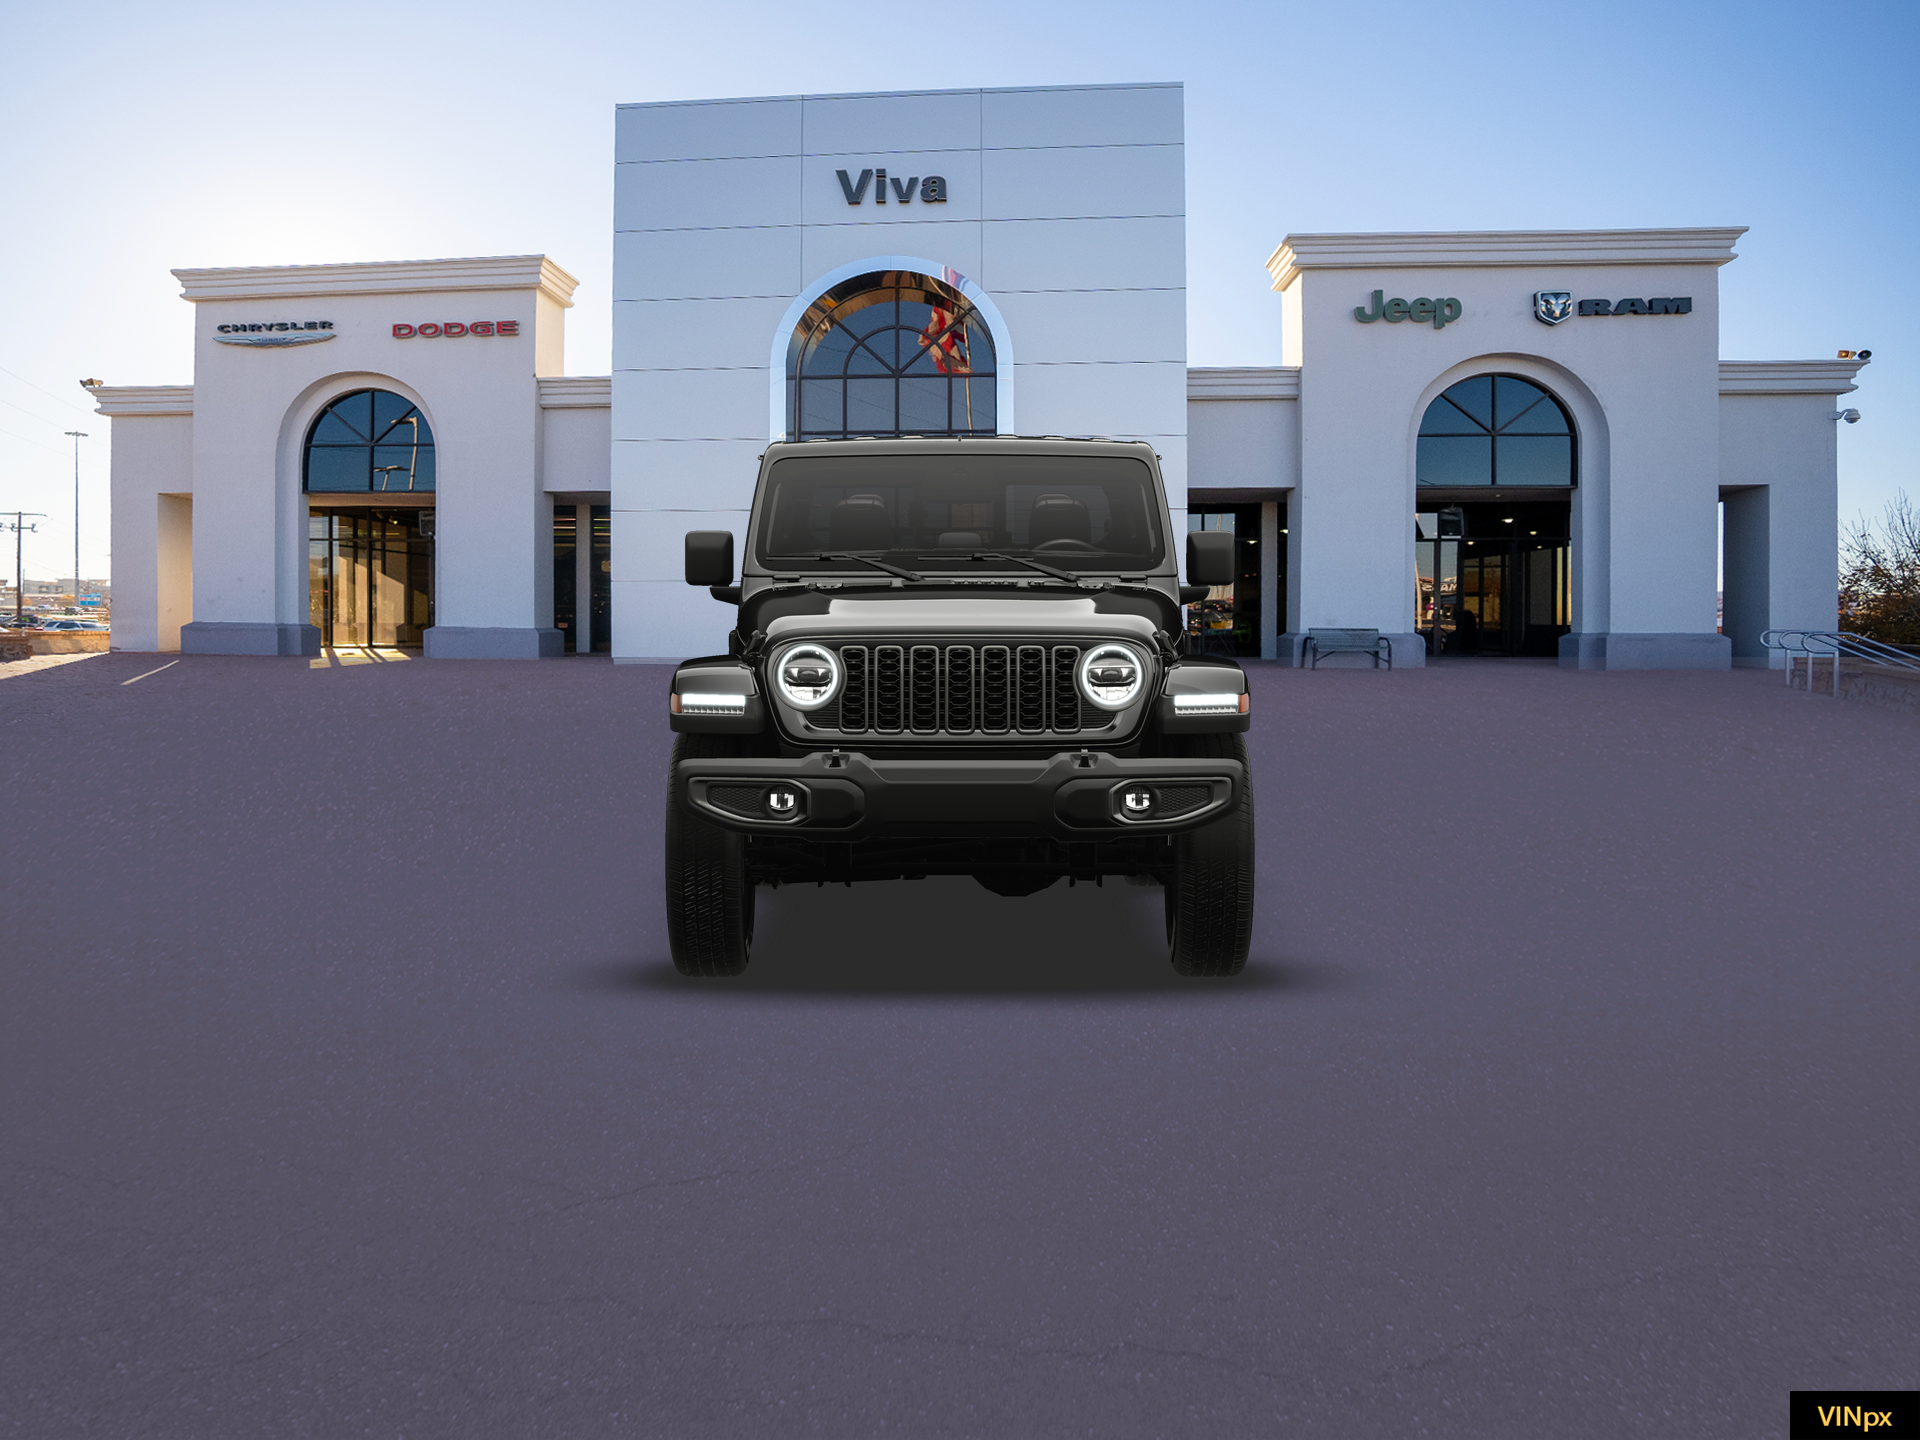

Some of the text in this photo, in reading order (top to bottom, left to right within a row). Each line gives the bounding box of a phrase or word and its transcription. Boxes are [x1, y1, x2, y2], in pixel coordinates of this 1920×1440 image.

[835, 168, 947, 205] Viva
[1354, 289, 1462, 330] Jeep
[1578, 297, 1692, 316] RAM
[217, 320, 334, 333] CHRYSLER
[392, 319, 519, 338] DODGE
